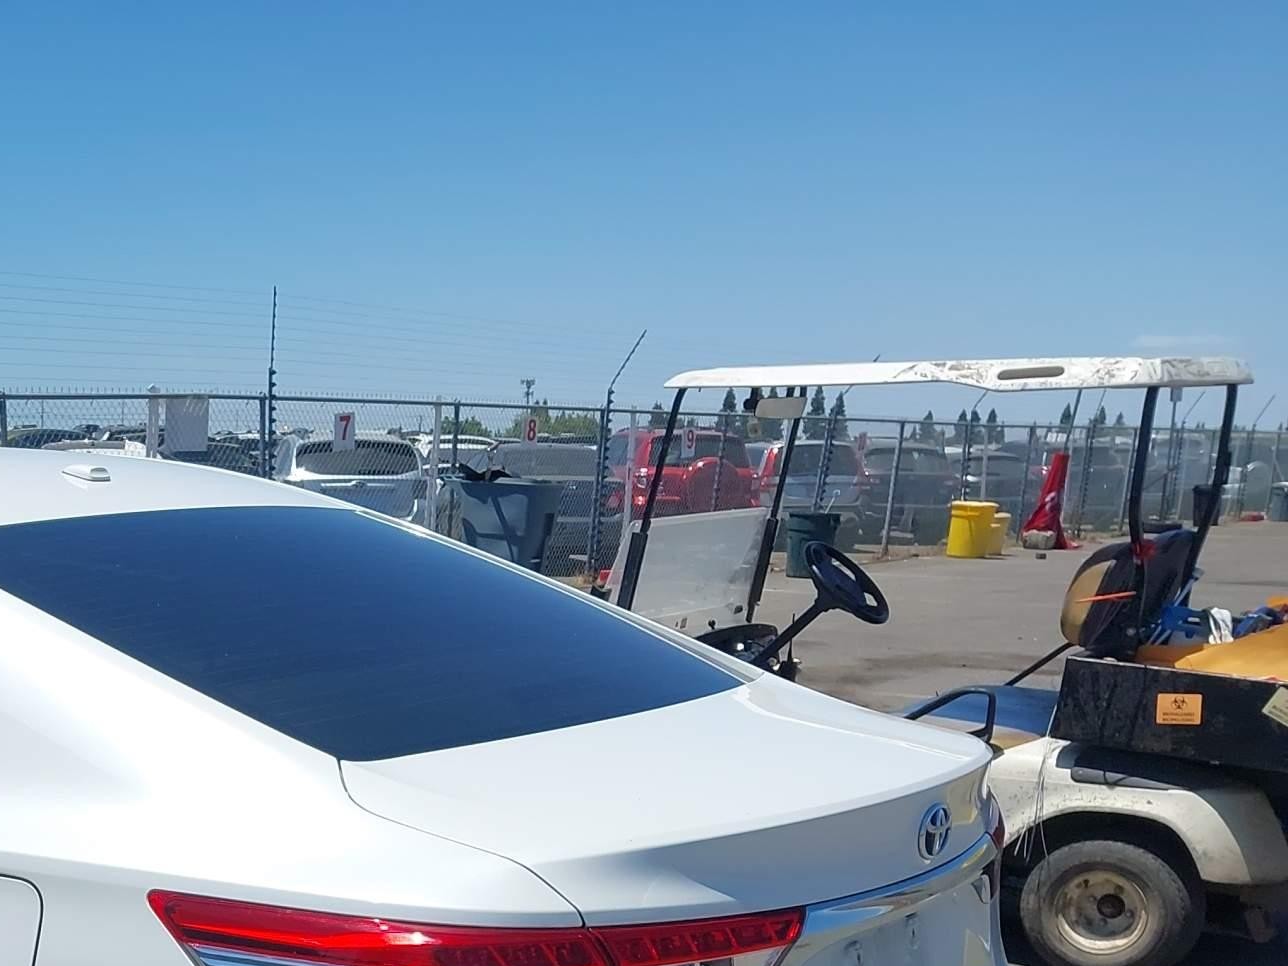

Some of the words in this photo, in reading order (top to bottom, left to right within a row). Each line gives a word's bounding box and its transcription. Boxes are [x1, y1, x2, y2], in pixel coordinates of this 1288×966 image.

[339, 415, 351, 441] 7
[527, 419, 537, 441] 8
[687, 430, 695, 449] 9
